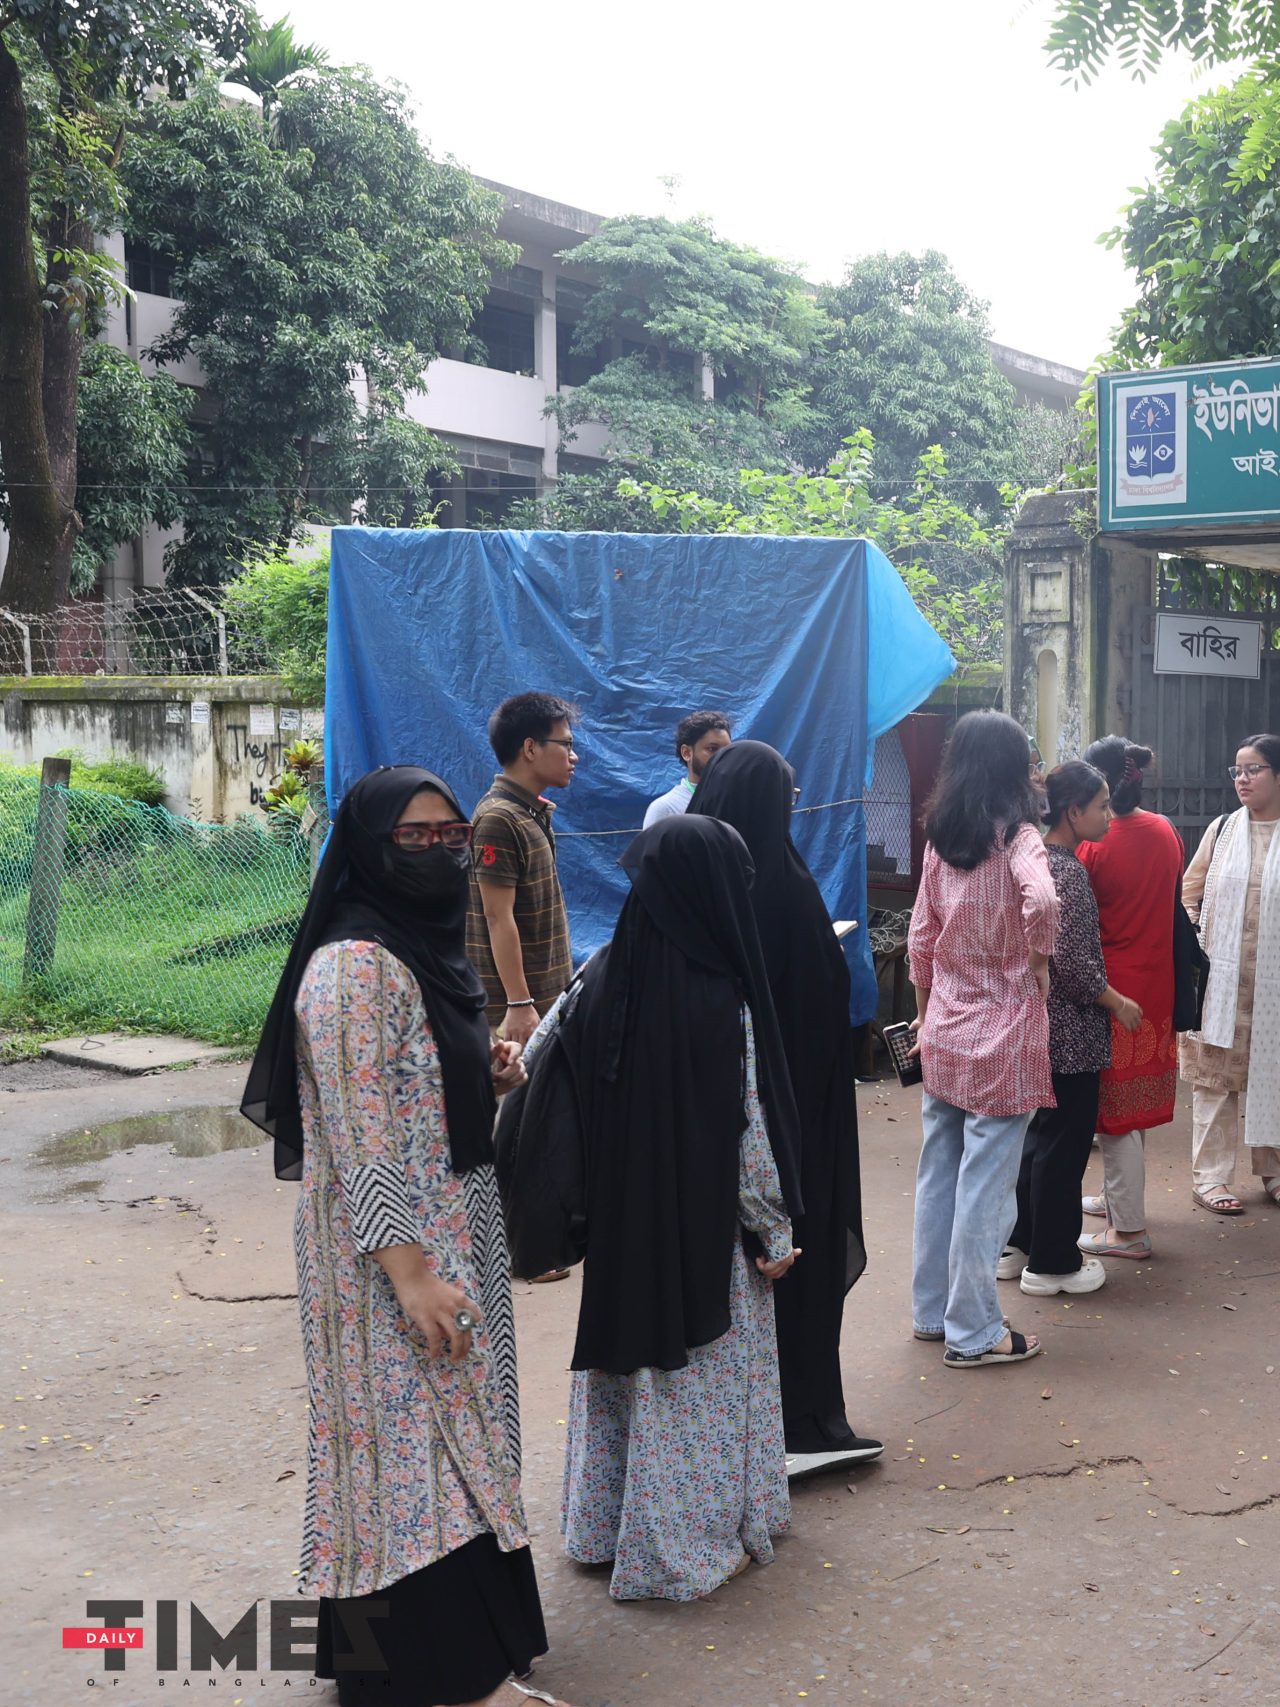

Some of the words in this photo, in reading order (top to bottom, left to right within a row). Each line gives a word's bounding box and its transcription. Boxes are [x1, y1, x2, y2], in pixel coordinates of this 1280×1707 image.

[1178, 626, 1241, 661] বাহির
[226, 725, 269, 778] They
[482, 844, 497, 865] 3
